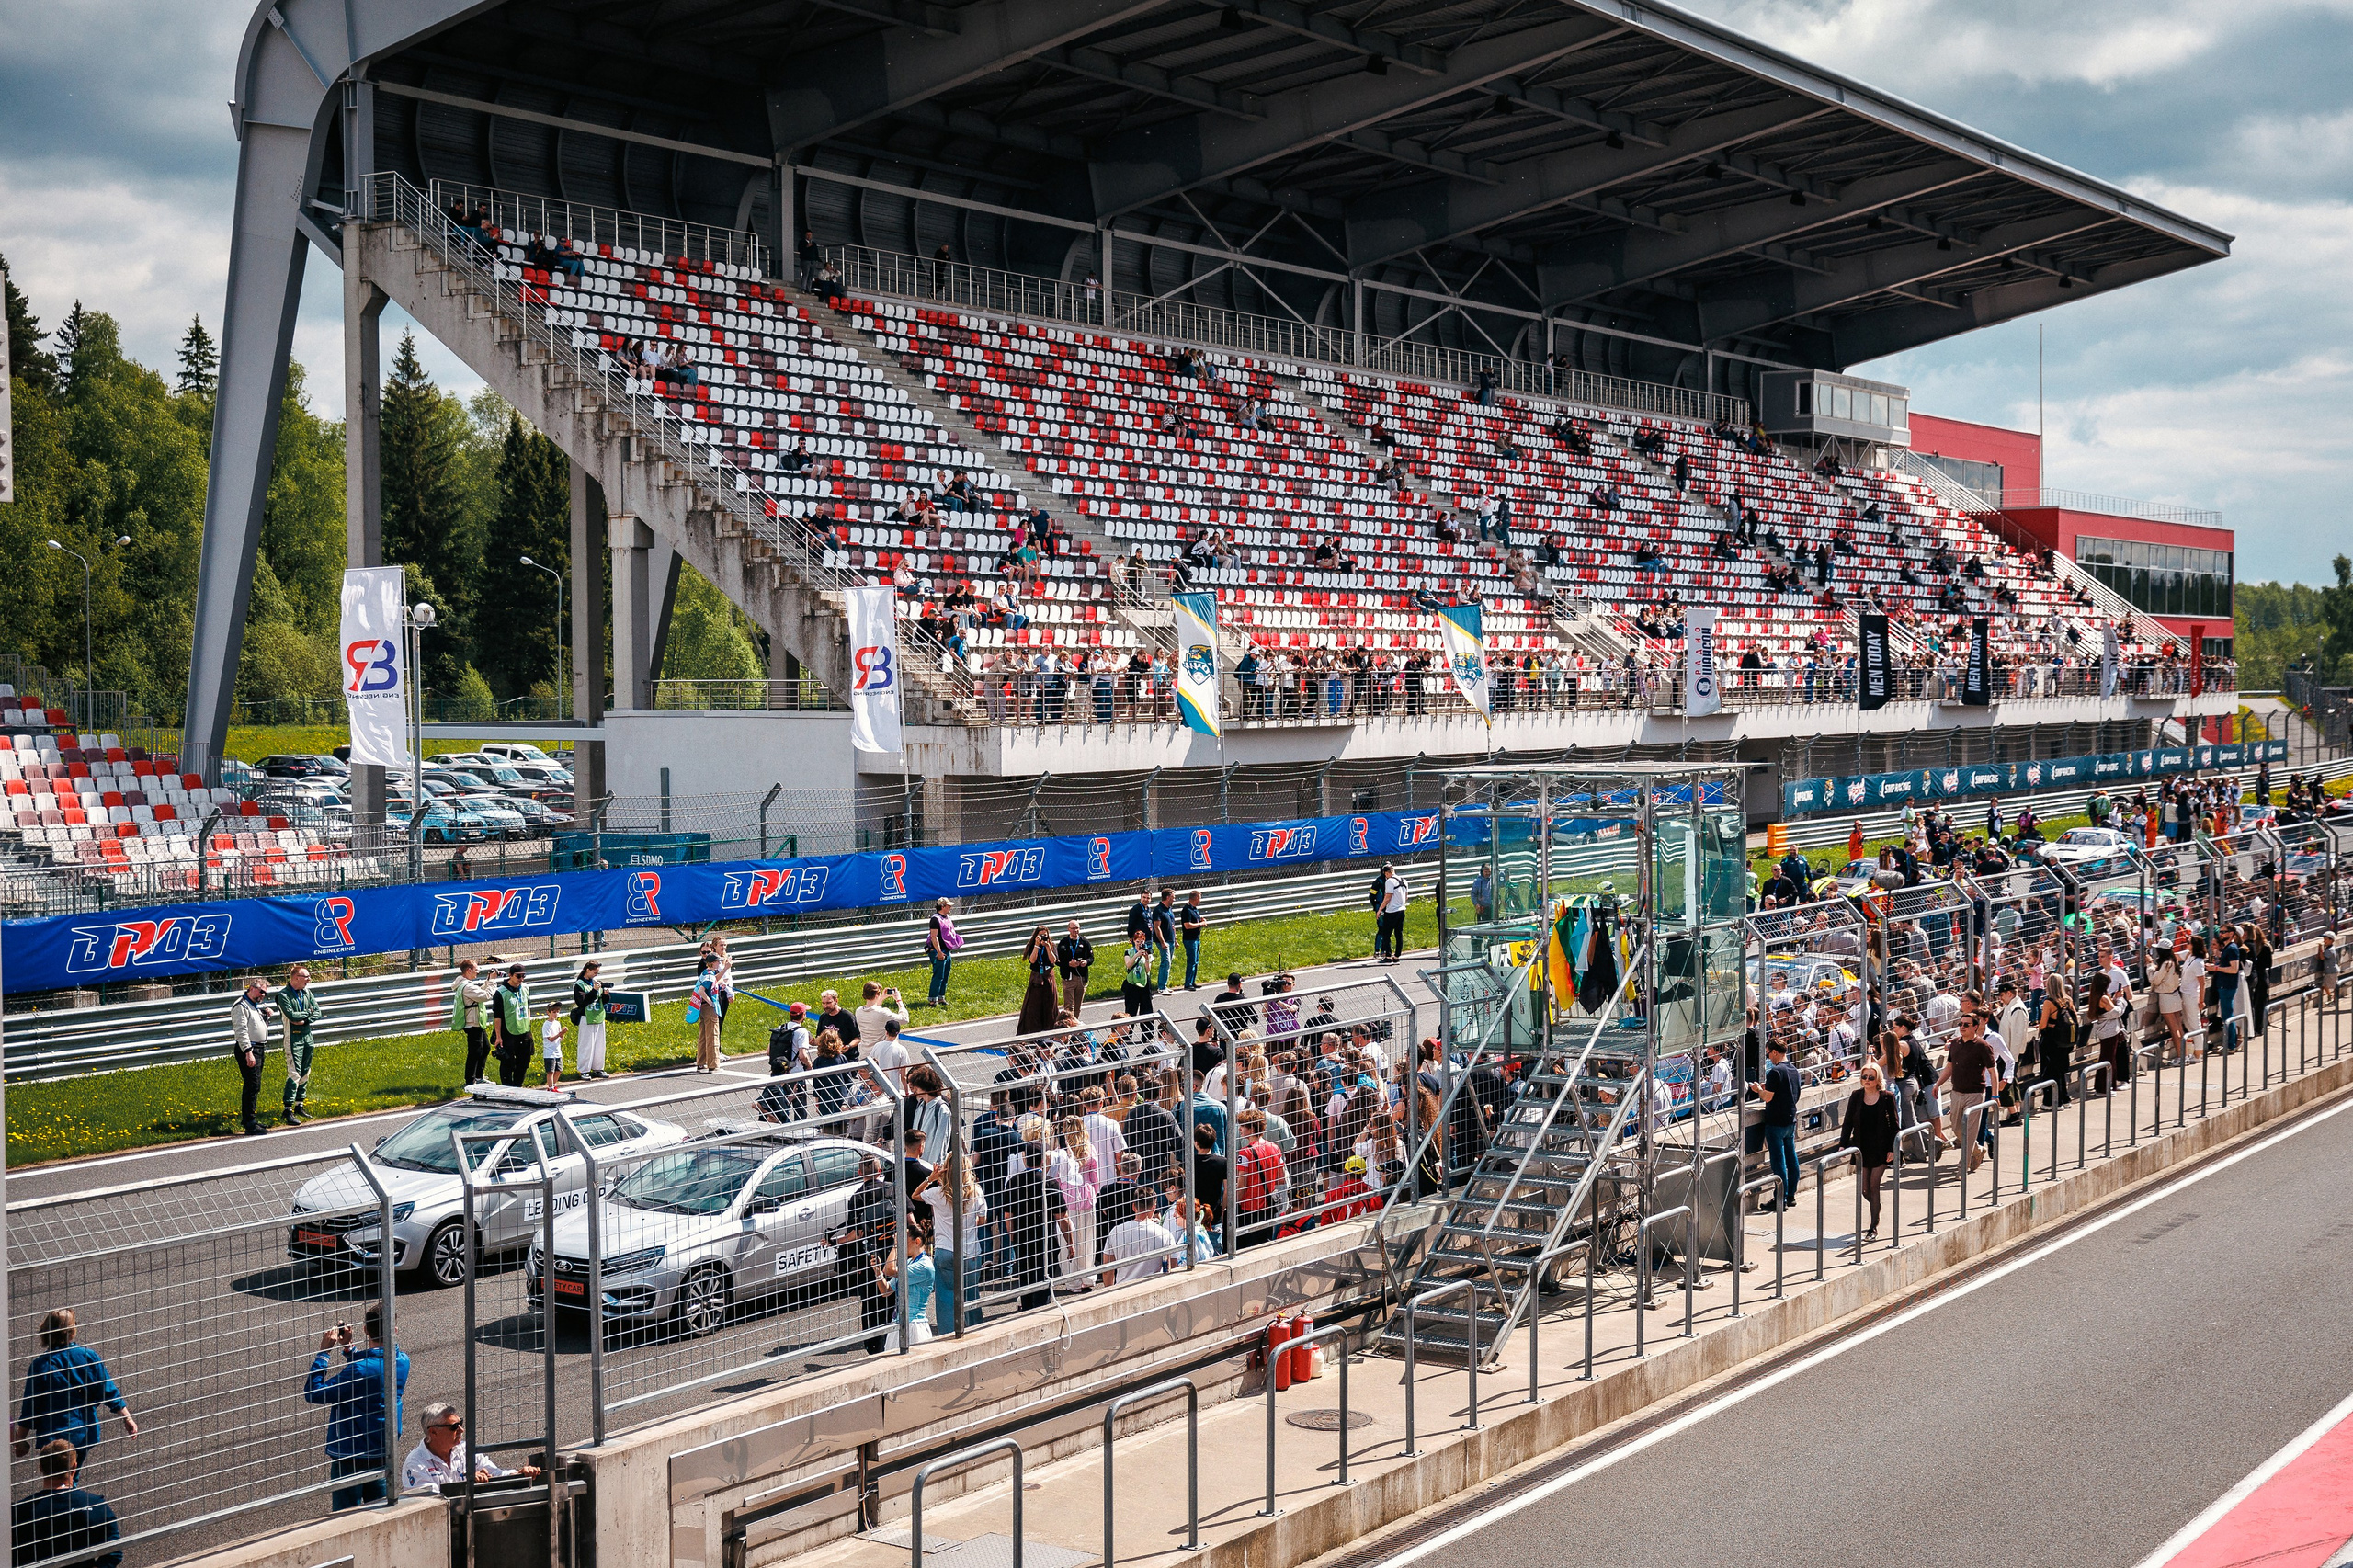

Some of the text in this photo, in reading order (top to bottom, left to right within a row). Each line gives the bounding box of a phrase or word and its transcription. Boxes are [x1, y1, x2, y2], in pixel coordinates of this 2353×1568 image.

[1702, 627, 1712, 675] ШАНСОН
[1867, 631, 1884, 696] MEN TODAY
[1967, 633, 1982, 691] MEN TODAY
[313, 946, 356, 955] ENGINEERING
[528, 1187, 606, 1217] LEDING CR
[779, 1245, 827, 1270] SAFETY
[568, 1285, 582, 1293] CAR
